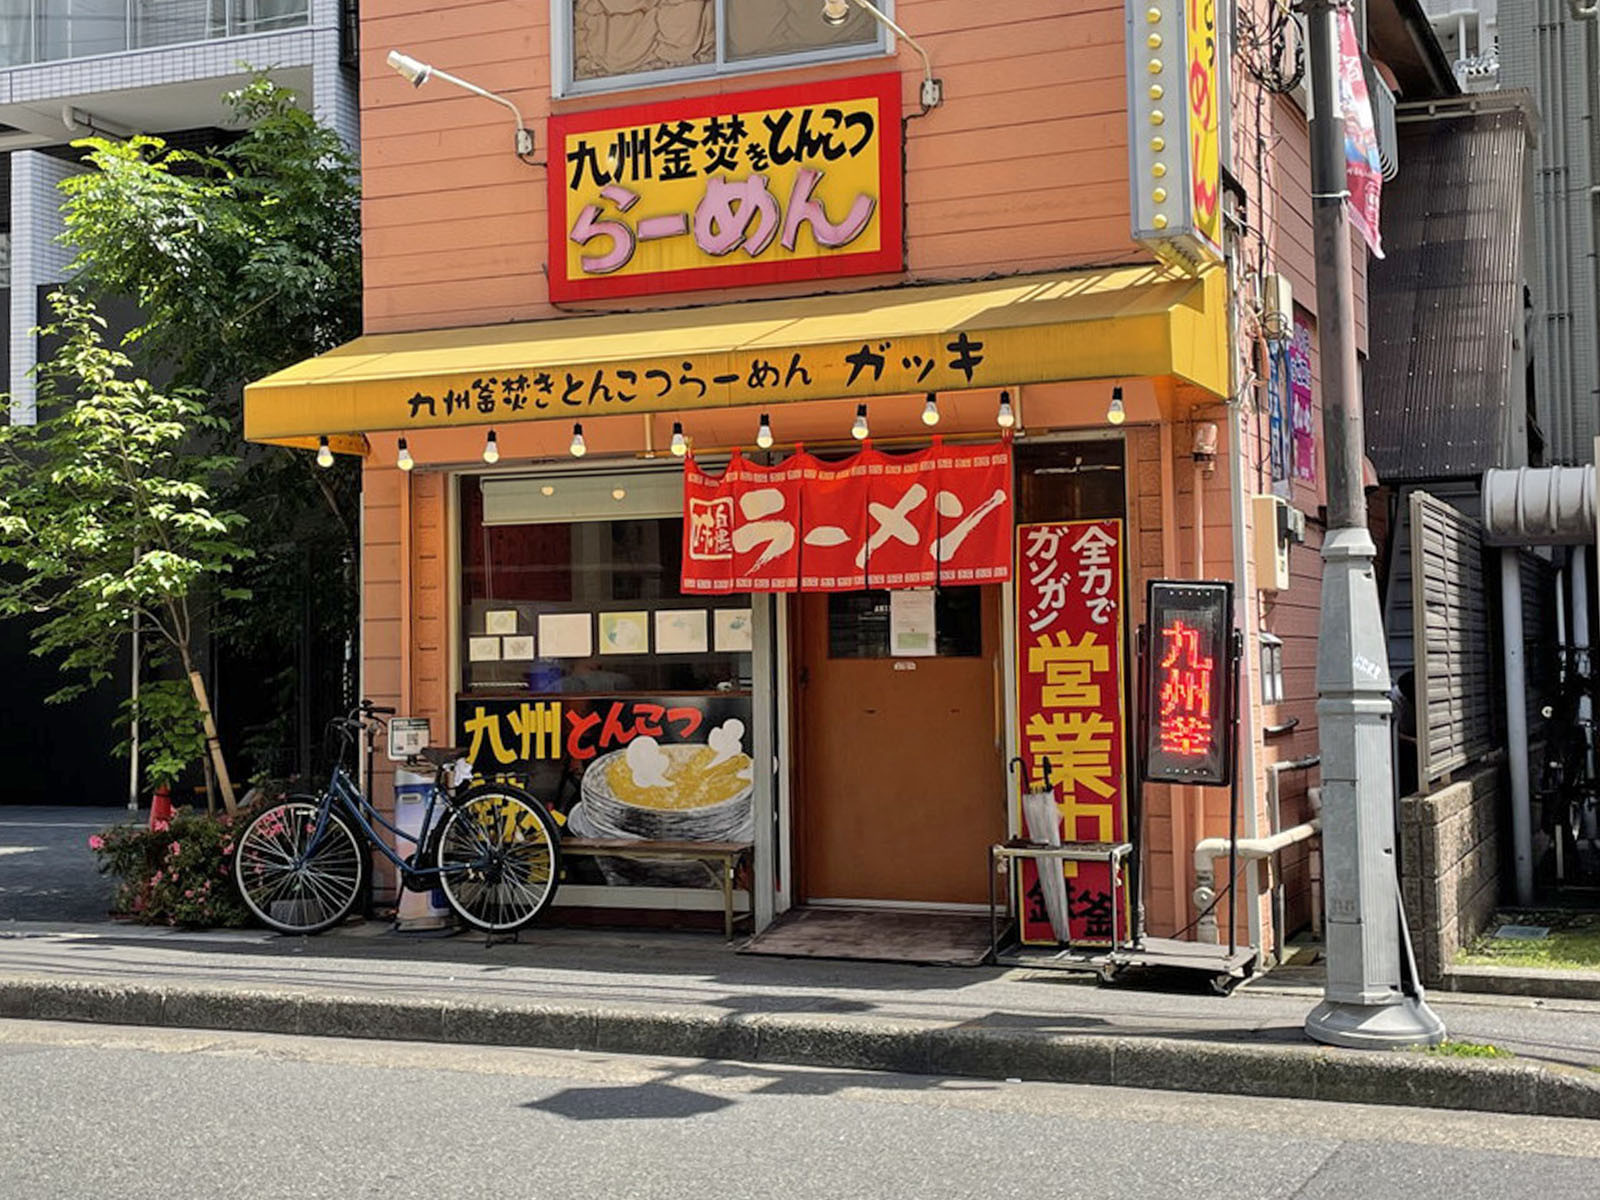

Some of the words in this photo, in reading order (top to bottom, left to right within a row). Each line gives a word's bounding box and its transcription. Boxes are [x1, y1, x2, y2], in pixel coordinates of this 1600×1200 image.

[567, 109, 874, 190] 九州釜焚きとんこつ
[570, 167, 877, 274] らーめん
[408, 352, 812, 418] 九州釜焚きとんこつらーめん
[845, 332, 985, 387] ガッキ
[731, 483, 1007, 576] ラーメン
[1071, 525, 1118, 625] 全力で
[1027, 525, 1072, 633] ガンガン
[463, 701, 703, 765] 九州とんこつ
